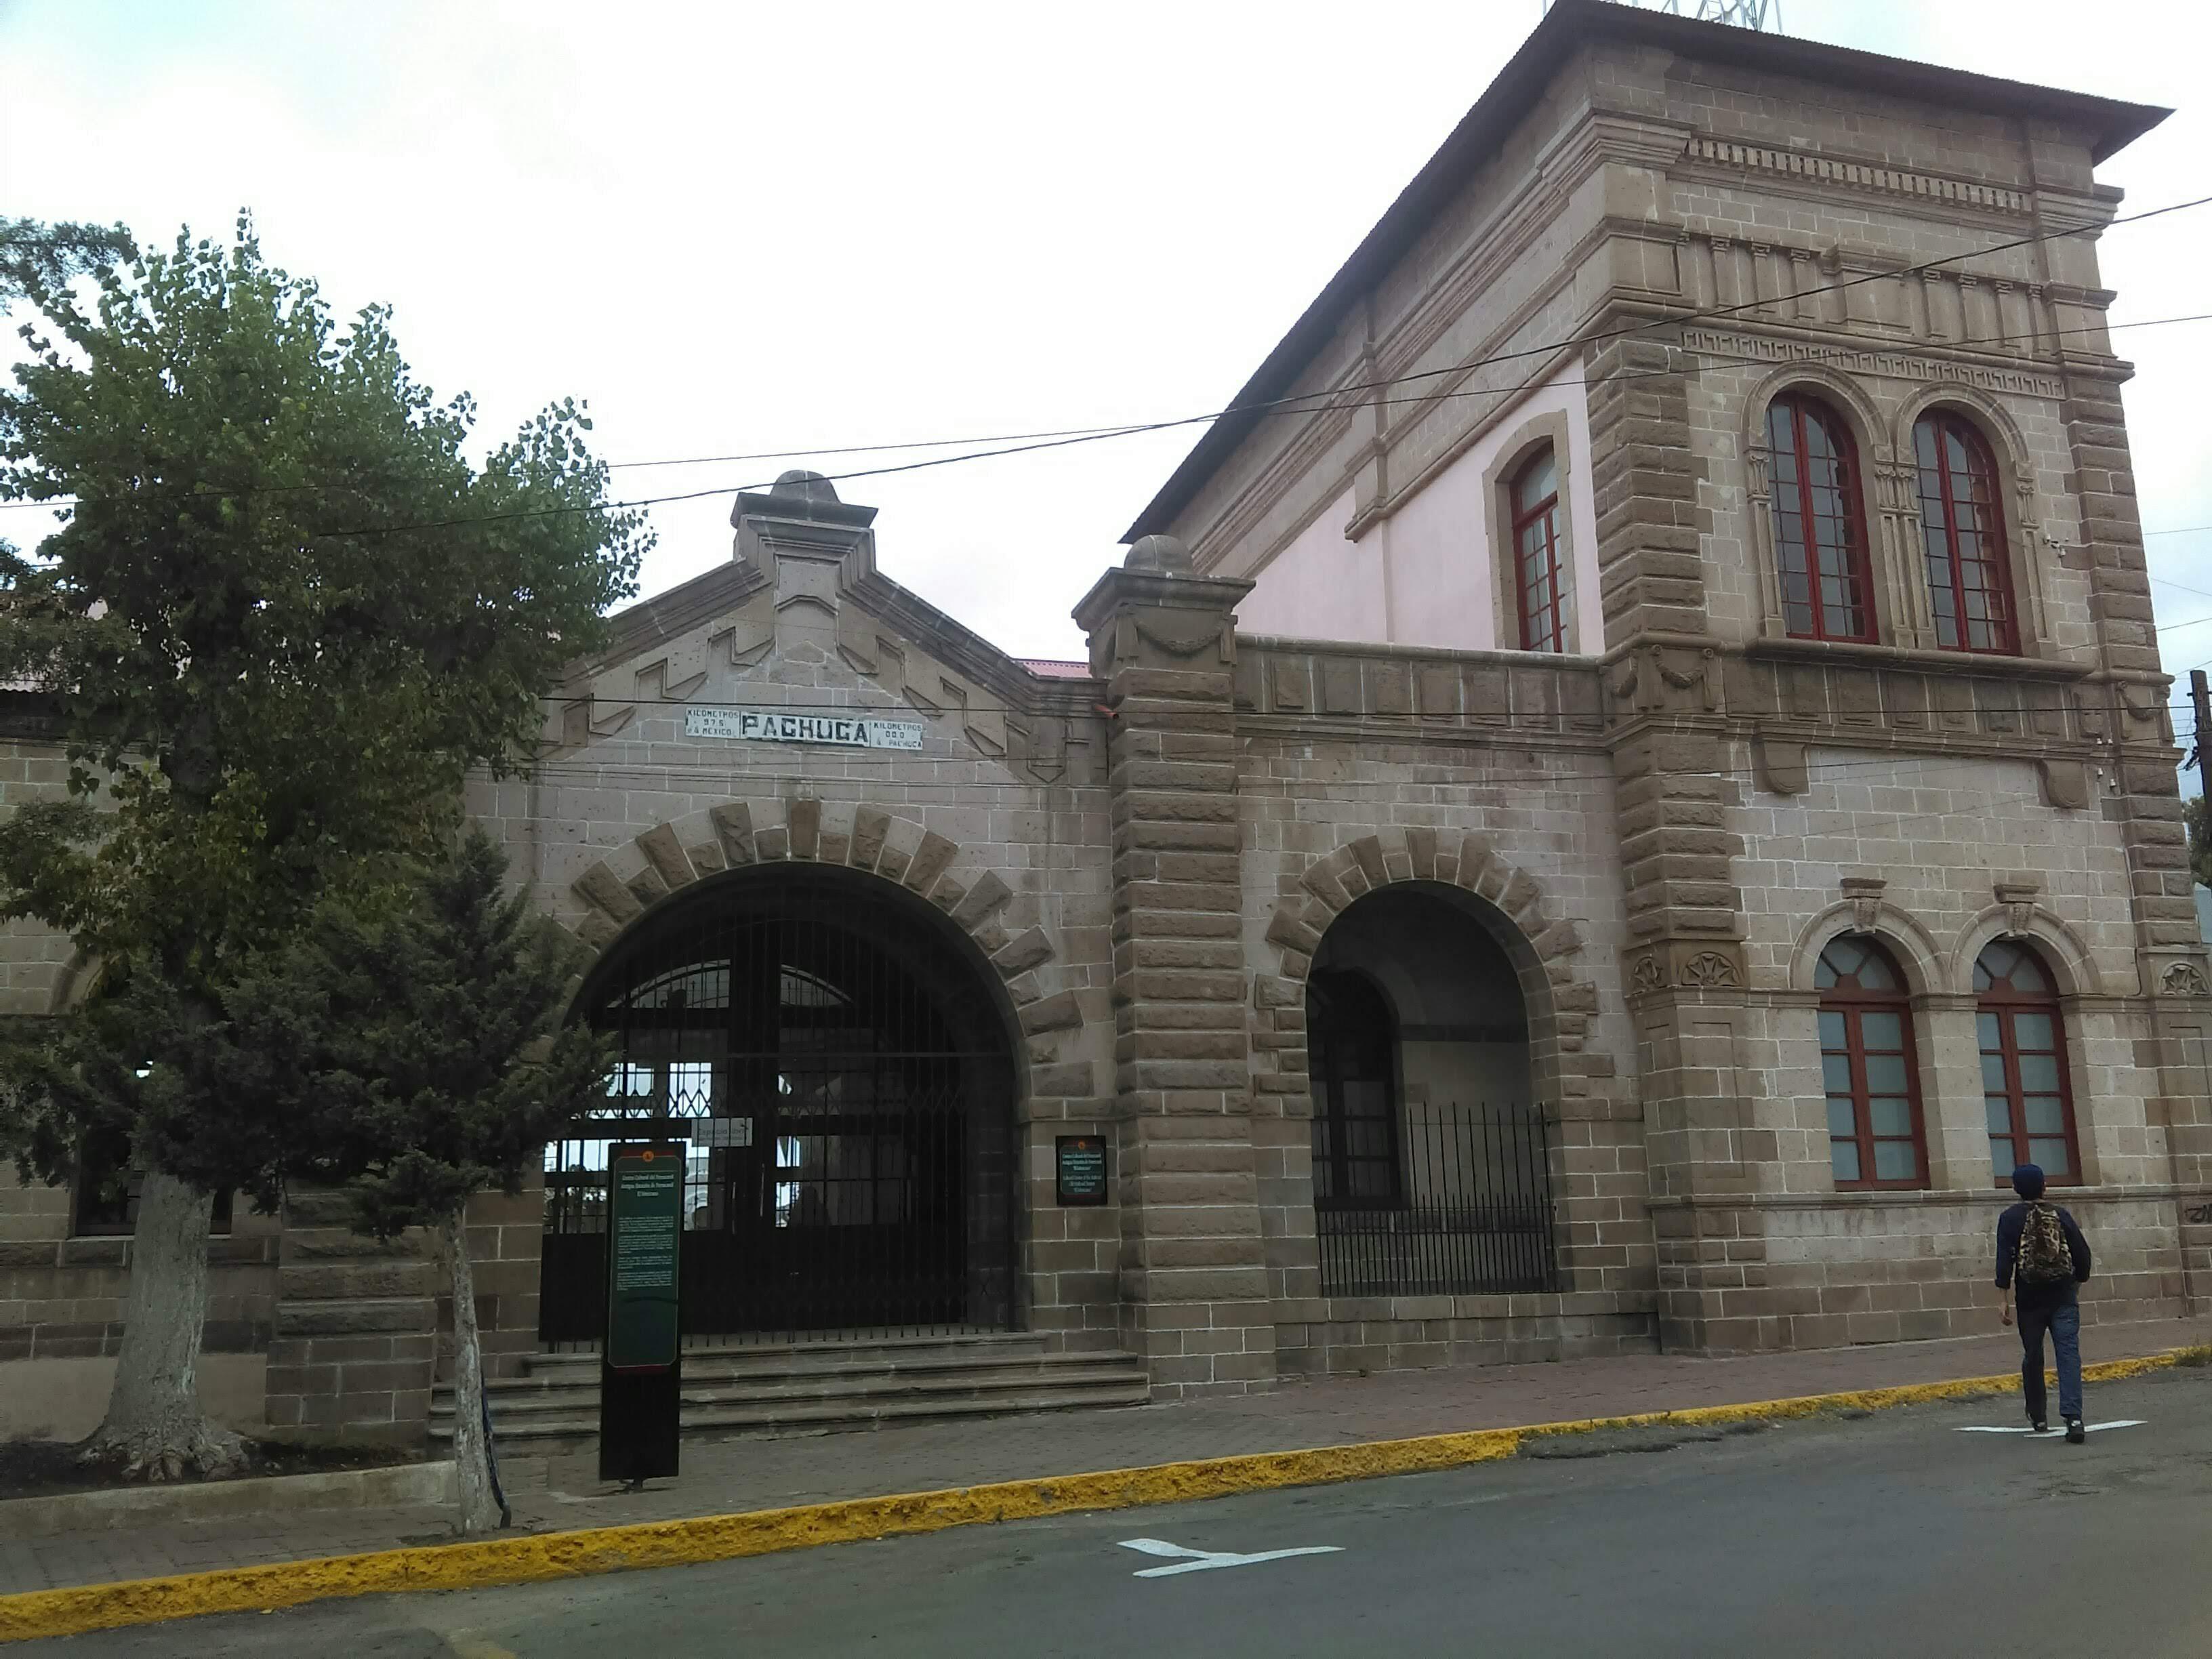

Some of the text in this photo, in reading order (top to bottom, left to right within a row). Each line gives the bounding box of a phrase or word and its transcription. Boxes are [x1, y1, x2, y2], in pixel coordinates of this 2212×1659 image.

[687, 710, 739, 718] KILOMETROS
[742, 716, 868, 742] PACHUCA
[874, 722, 922, 731] KILOMETROS
